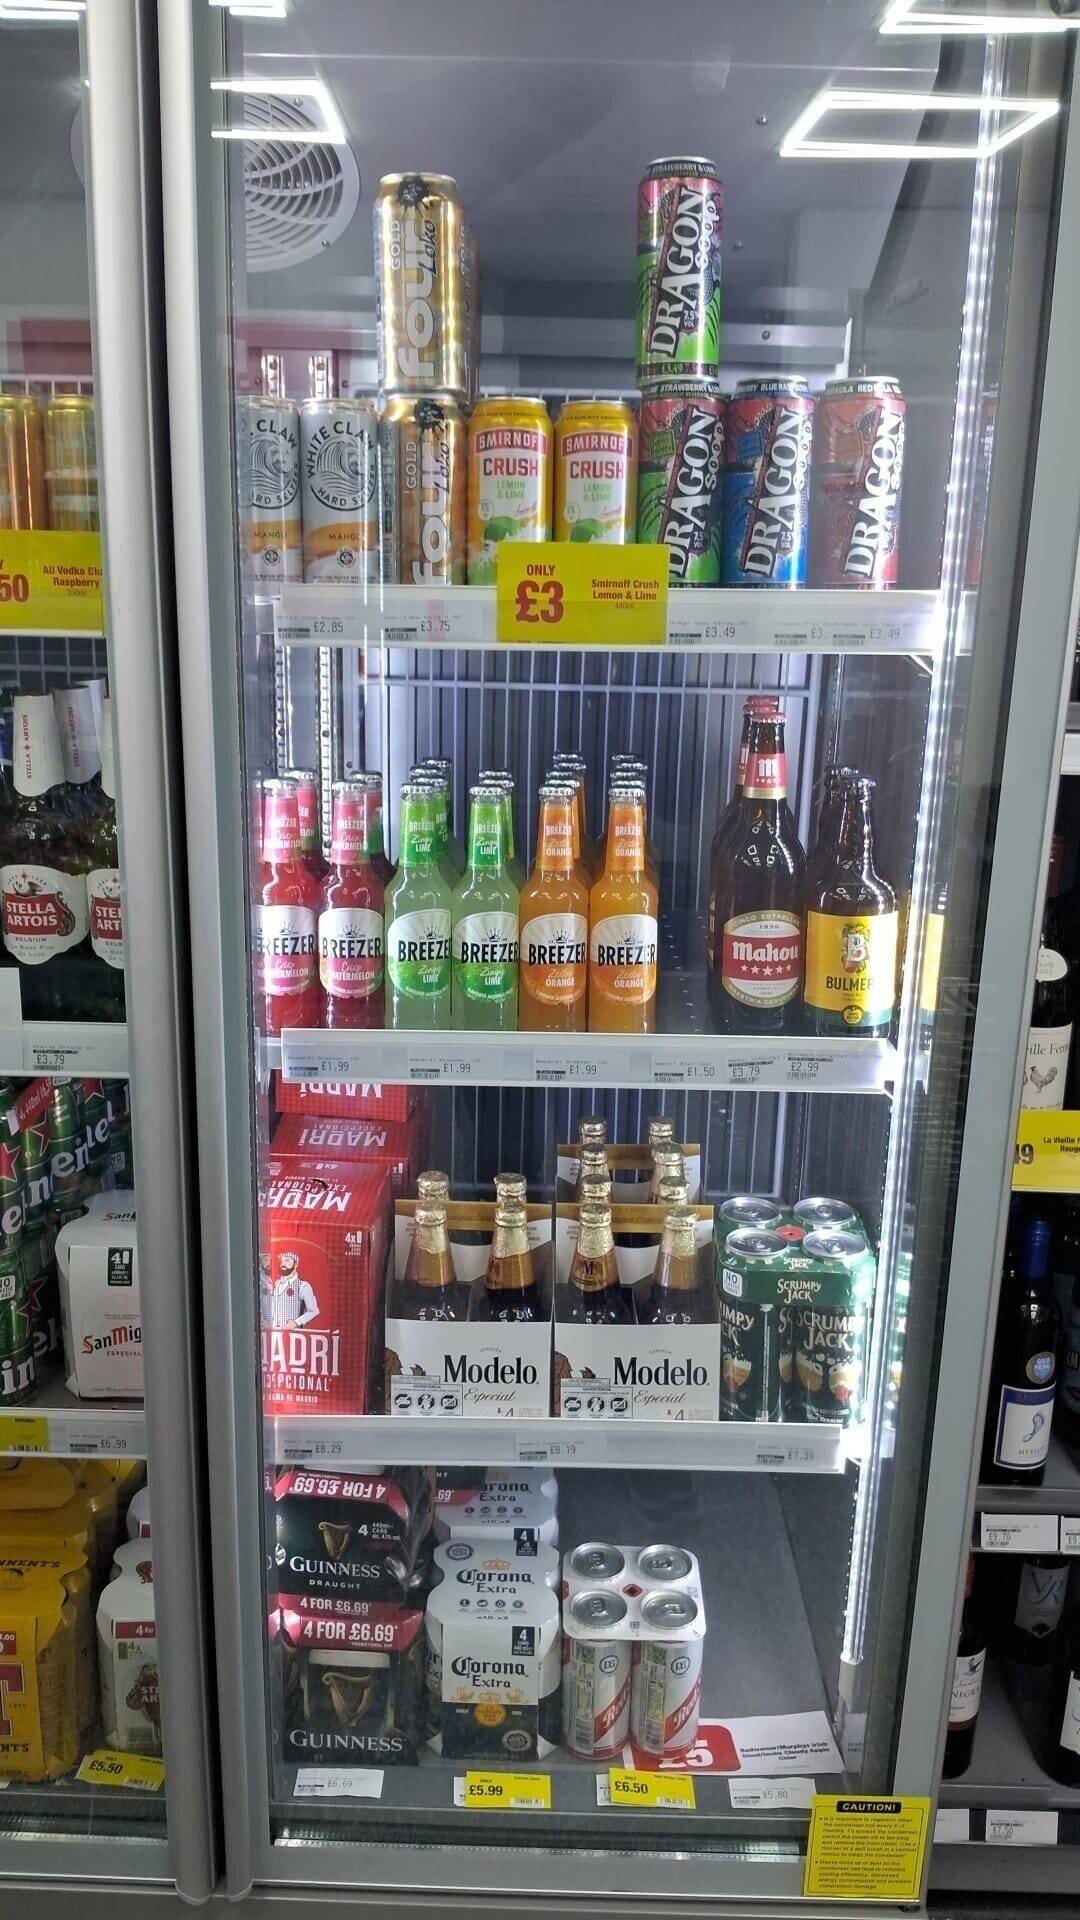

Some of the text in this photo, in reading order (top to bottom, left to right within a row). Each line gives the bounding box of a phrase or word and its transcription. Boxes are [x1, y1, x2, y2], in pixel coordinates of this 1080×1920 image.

[391, 220, 401, 270] GOLD
[418, 219, 437, 275] Loko
[650, 185, 706, 356] DRAGON
[660, 384, 707, 393] STRAWBERRY
[761, 383, 777, 392] BLUE
[858, 383, 873, 393] RED
[257, 418, 298, 449] CLAW
[479, 431, 543, 450] SMIRNOF
[307, 420, 376, 479] WHITE CLAW
[405, 441, 417, 489] GOLD
[434, 442, 451, 495] Loko
[483, 457, 539, 477] CRUSH
[569, 460, 625, 480] CRUSH
[496, 479, 526, 490] LEMON
[583, 482, 612, 492] LEMON
[317, 487, 347, 507] HARD
[505, 490, 525, 499] LIME
[592, 492, 611, 503] LIME
[668, 407, 717, 578] DRAGON
[744, 407, 800, 577] DRAGON
[844, 407, 903, 577] DRAGON
[57, 566, 85, 577] Vodka
[526, 564, 556, 576] ONLY
[53, 577, 101, 589] Raspberry
[591, 577, 660, 590] Smirnoff Crush
[515, 580, 564, 624] £3
[592, 590, 657, 602] Lemon & Lime
[313, 622, 344, 633] £2.85
[420, 620, 451, 632] £3.75
[705, 627, 736, 639] £3.49
[869, 628, 900, 640] £3.49
[22, 713, 30, 741] ARTOIS
[409, 821, 435, 832] BREEZER
[545, 824, 572, 836] BREEZER
[615, 824, 641, 837] BREEZER
[415, 843, 432, 852] LIME
[480, 845, 497, 855] LIME
[545, 847, 572, 857] ORANGE
[614, 847, 641, 857] ORANGE
[6, 901, 57, 914] STELLA
[7, 914, 58, 927] ARTOIS
[322, 937, 382, 959] BREEZER
[461, 941, 519, 964] BREEZER
[529, 942, 586, 966] BREEZER
[732, 940, 799, 963] Mahou
[597, 944, 656, 967] BREEZER
[422, 974, 439, 984] LIME
[484, 976, 502, 986] LIME
[545, 978, 575, 988] ORANGE
[614, 978, 645, 989] ORANGE
[36, 1054, 65, 1065] £3.79
[321, 1061, 350, 1072] £1.99
[443, 1063, 471, 1074] £1.99
[569, 1064, 597, 1076] £1.99
[687, 1066, 715, 1077] £1.50
[732, 1066, 760, 1078] £3.79
[791, 1061, 819, 1073] £2.99
[298, 1129, 388, 1147] MADRÍ
[1043, 1135, 1075, 1144] La Vieille
[271, 1180, 348, 1193] EXCPCIONAL
[111, 1252, 121, 1264] 4
[789, 1260, 809, 1270] JACK
[726, 1270, 739, 1284] NO
[777, 1278, 822, 1294] SCRUMPY
[784, 1286, 813, 1304] JACK
[804, 1327, 850, 1350] JACK
[444, 1354, 537, 1385] Modelo
[614, 1356, 709, 1386] Modelo
[464, 1387, 517, 1404] Especial
[633, 1390, 686, 1405] Especial
[100, 1439, 127, 1449] £6.99
[315, 1444, 342, 1454] £8.29
[550, 1444, 576, 1455] £8.19
[788, 1450, 814, 1461] £7.39
[342, 1481, 386, 1499] 4 FOR
[480, 1493, 517, 1503] Extra
[358, 1523, 369, 1536] 4
[519, 1530, 528, 1542] 4
[988, 1532, 1011, 1541] £9.70
[289, 1555, 381, 1579] GUINNESS
[456, 1568, 533, 1587] Corona
[309, 1579, 361, 1590] DRAUGHT
[476, 1583, 517, 1594] Extra
[300, 1597, 308, 1608] 4
[310, 1598, 333, 1610] FOR
[136, 1624, 143, 1636] 4
[304, 1620, 313, 1638] 4
[316, 1621, 346, 1640] FOR
[519, 1629, 527, 1641] 4
[451, 1656, 528, 1676] Corona
[472, 1675, 511, 1688] Extra
[289, 1729, 403, 1753] GUINNESS
[88, 1759, 124, 1775] £5.50
[327, 1779, 353, 1789] £6.69
[469, 1784, 503, 1796] £5.99
[614, 1780, 649, 1794] £6.50
[762, 1790, 788, 1799] £5.80
[842, 1802, 896, 1812] CAUTION!
